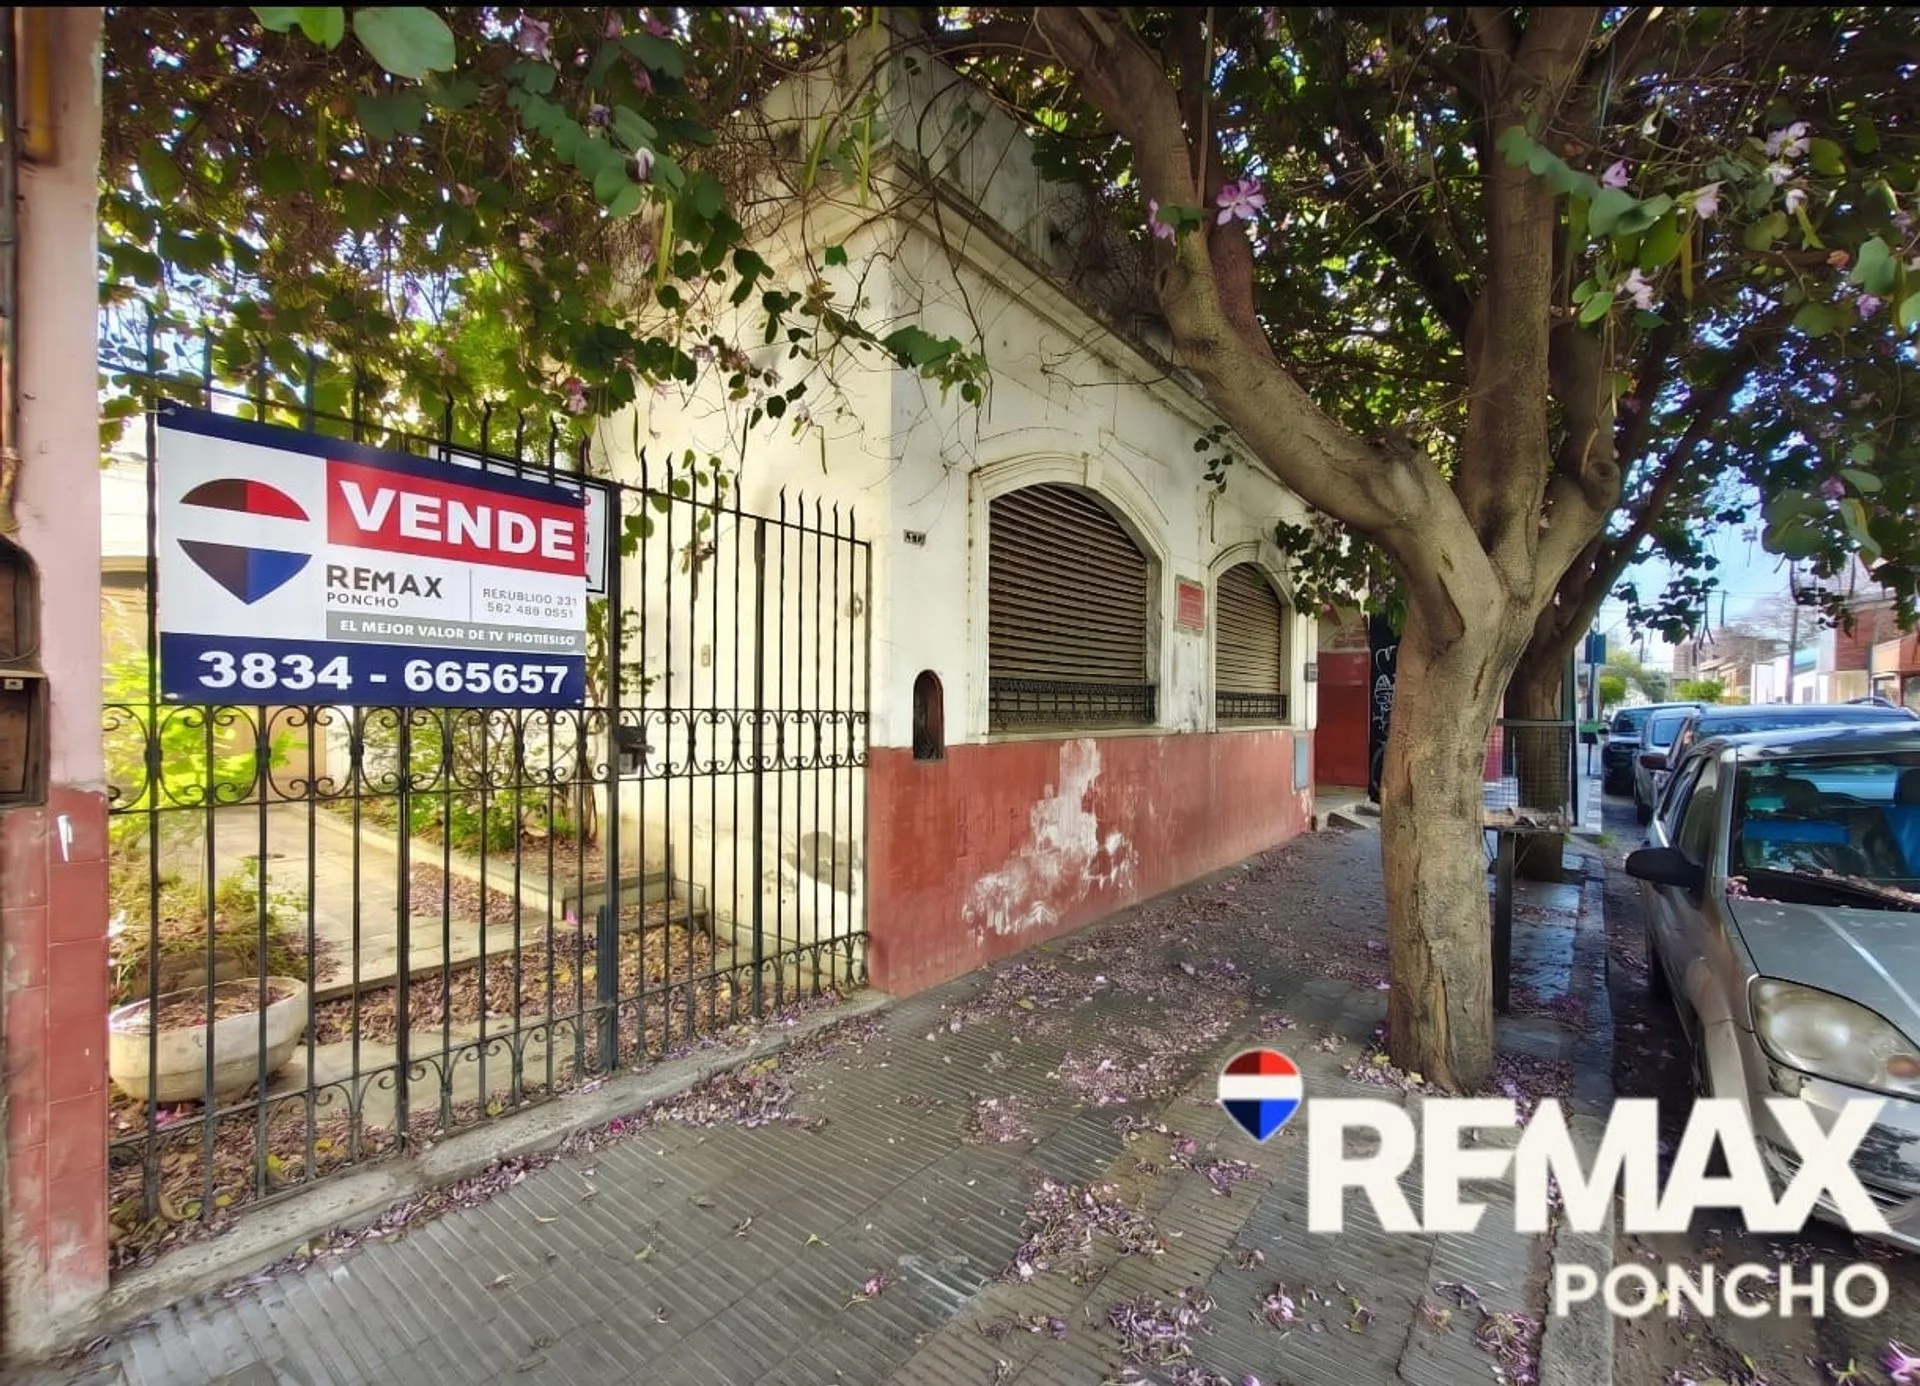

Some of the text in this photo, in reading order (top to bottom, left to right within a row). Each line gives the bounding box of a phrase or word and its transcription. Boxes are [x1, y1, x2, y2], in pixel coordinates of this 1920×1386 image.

[339, 480, 576, 561] VENDE
[326, 564, 442, 599] REMAX
[327, 591, 399, 609] PONCHO
[340, 620, 356, 632] EL
[362, 620, 413, 636] MEJOR
[418, 625, 464, 639] VALOR
[469, 629, 485, 640] DE
[198, 650, 352, 691] 3834
[403, 659, 568, 694] 665657
